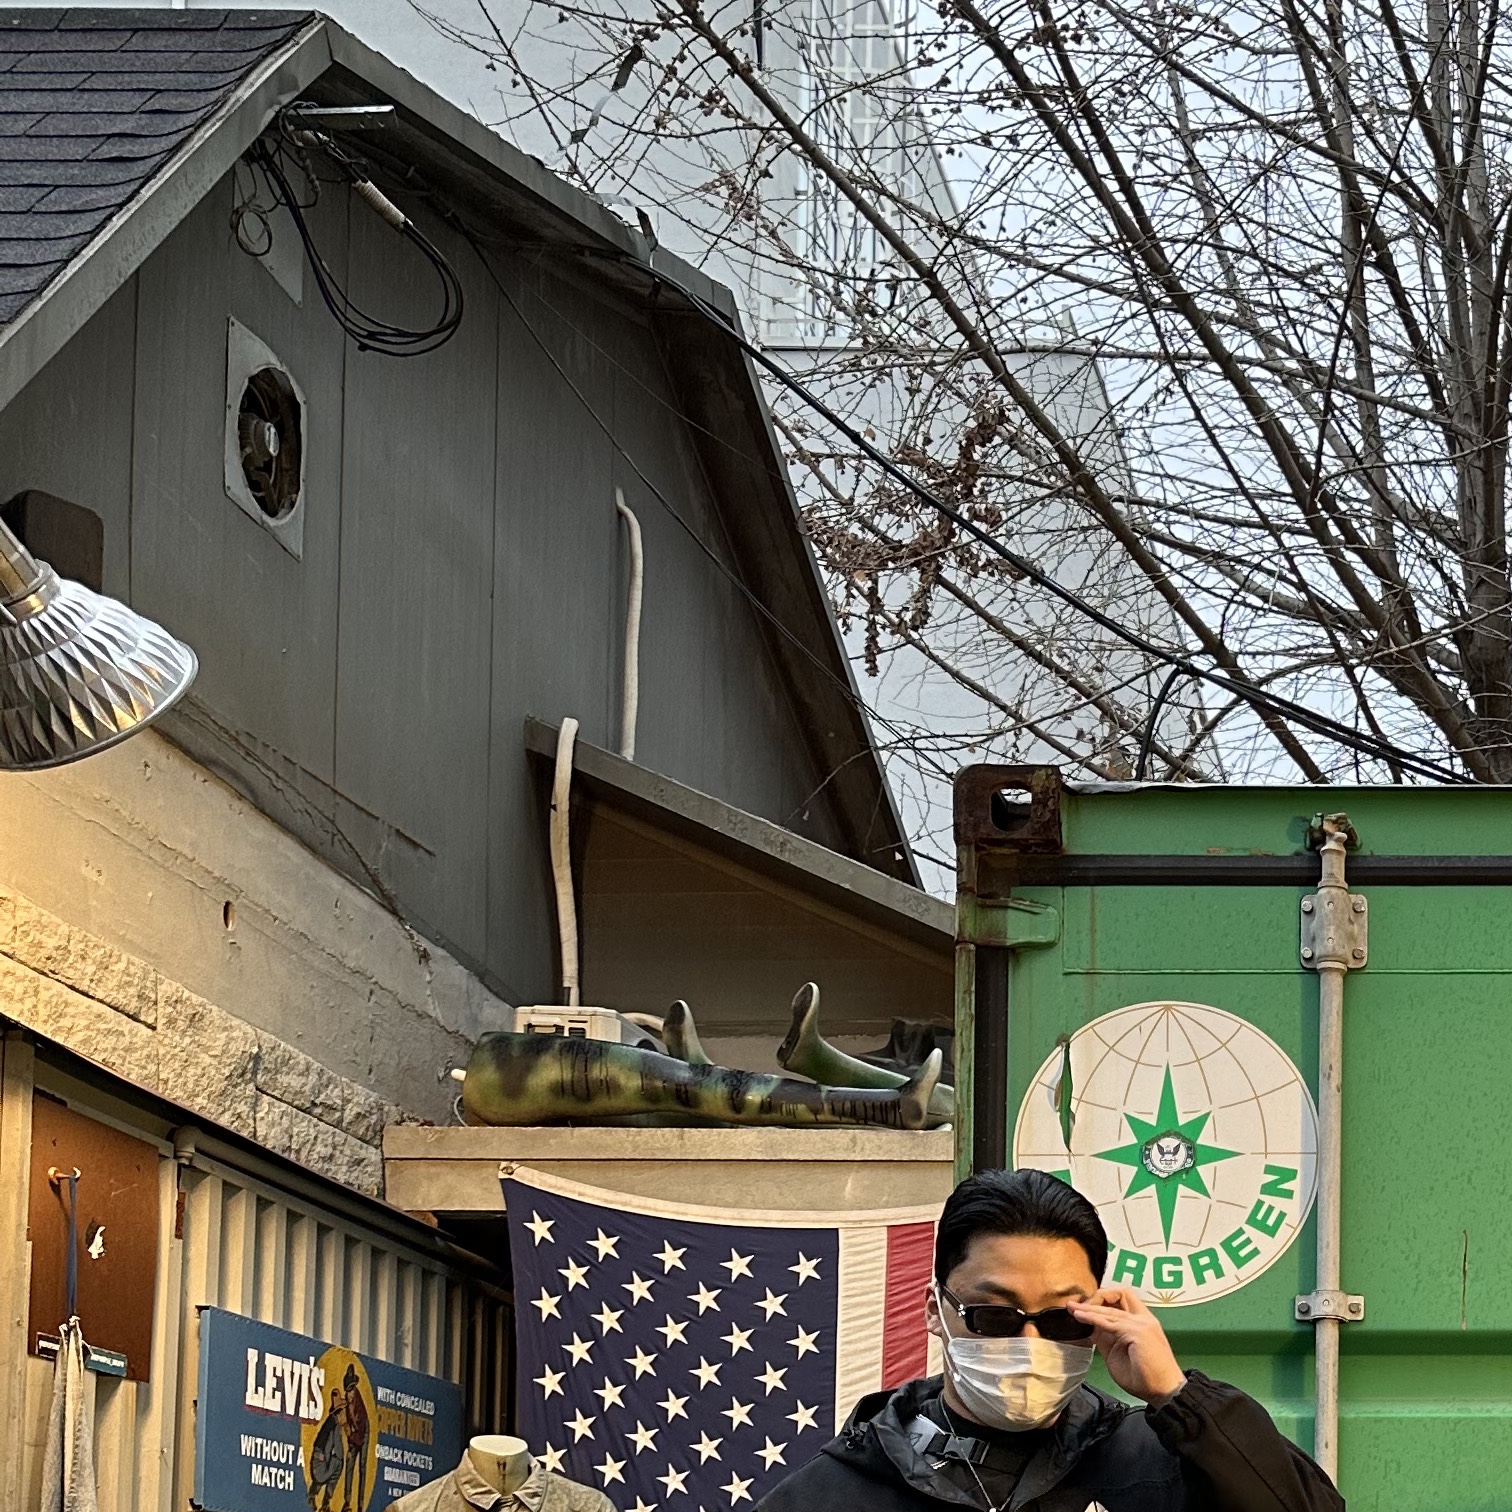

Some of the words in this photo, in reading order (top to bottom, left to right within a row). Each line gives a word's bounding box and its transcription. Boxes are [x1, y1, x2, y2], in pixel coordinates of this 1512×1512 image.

[1107, 1164, 1298, 1289] RGREEN
[246, 1348, 325, 1421] LEVI'S
[241, 1434, 296, 1465] WITHOUT
[252, 1464, 294, 1491] MATCH
